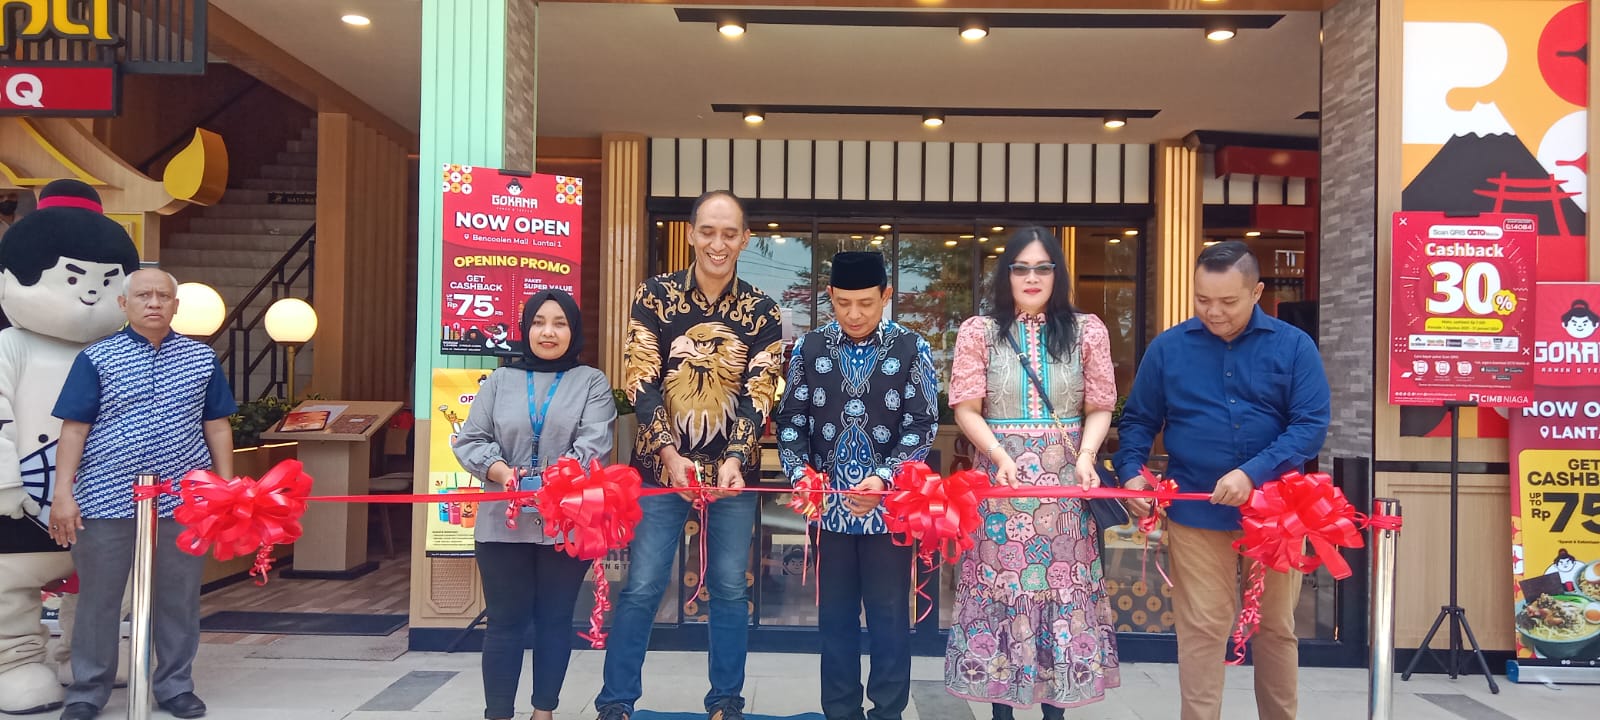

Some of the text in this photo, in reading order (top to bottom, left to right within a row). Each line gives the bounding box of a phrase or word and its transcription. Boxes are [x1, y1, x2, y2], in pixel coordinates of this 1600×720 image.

[0, 73, 44, 107] Q
[492, 195, 538, 208] GOKANA
[455, 212, 570, 236] NOW OPEN
[514, 237, 529, 245] Mall
[533, 239, 556, 247] Lantai
[1425, 242, 1504, 257] Cashback
[454, 255, 571, 275] OPENING PROMO
[450, 281, 503, 291] CASHBACK
[1534, 341, 1600, 363] GOKA
[460, 395, 475, 403] OP
[1480, 394, 1529, 403] CIMB NIAGA
[1523, 400, 1600, 417] NOW O
[1552, 425, 1600, 439] LANT
[1568, 458, 1600, 471] GET
[1531, 508, 1551, 521] Rp
